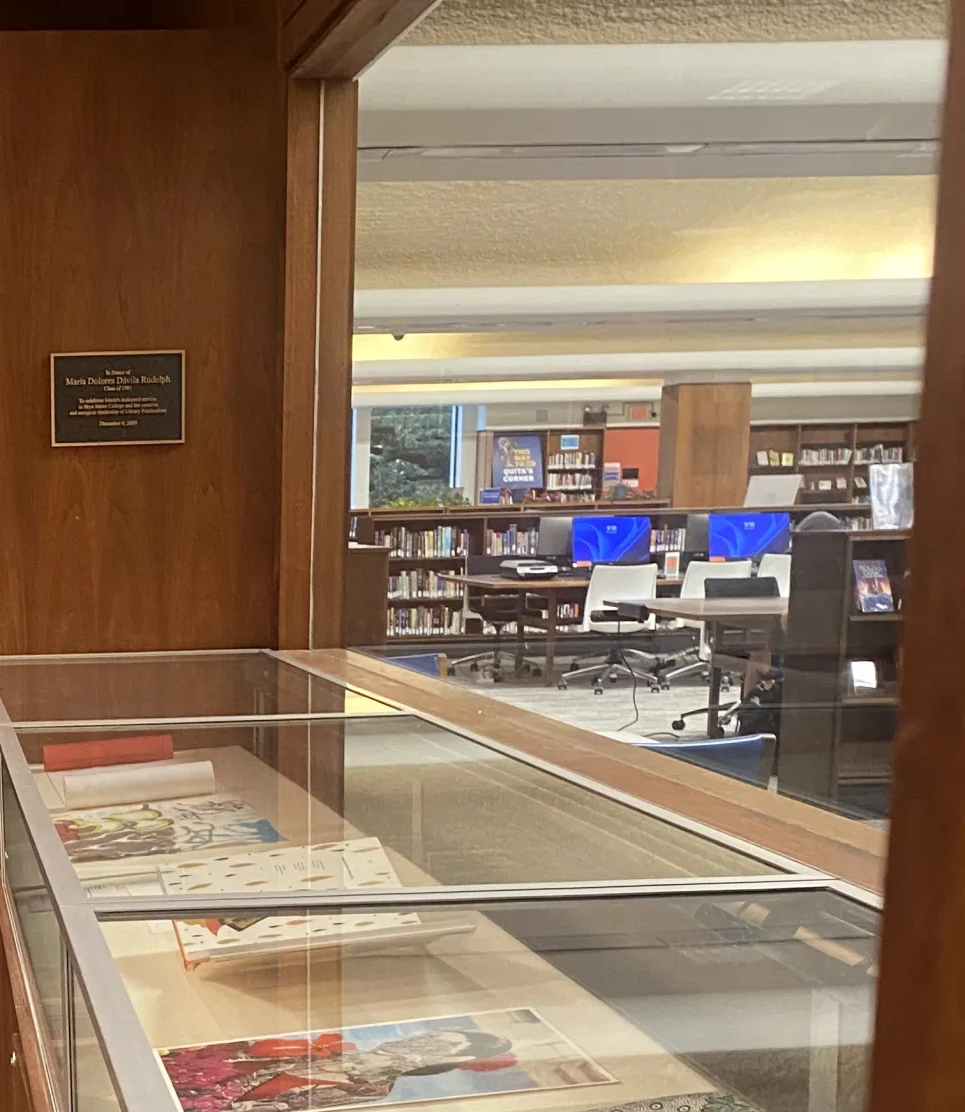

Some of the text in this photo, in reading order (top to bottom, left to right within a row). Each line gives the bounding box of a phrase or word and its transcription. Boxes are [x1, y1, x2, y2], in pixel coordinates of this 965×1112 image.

[87, 376, 115, 385] Dolores
[141, 375, 171, 385] Rudolph
[503, 467, 534, 475] QUITA'S
